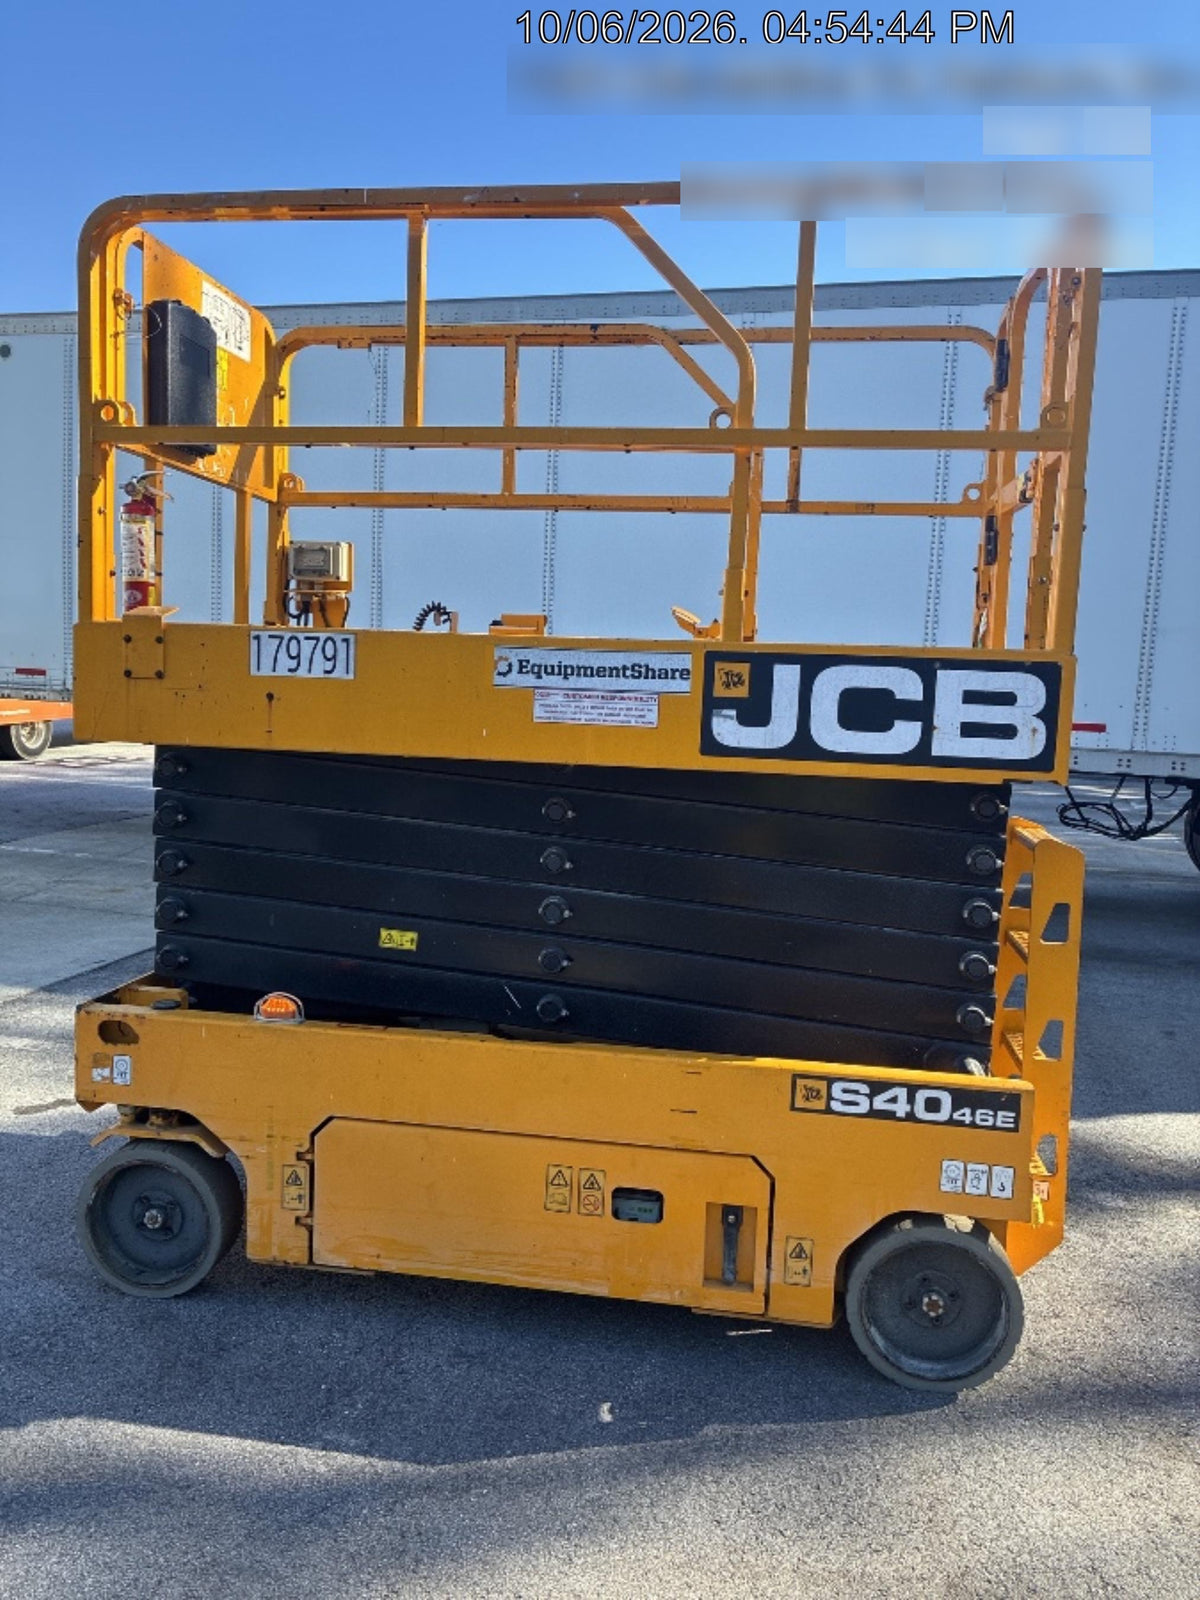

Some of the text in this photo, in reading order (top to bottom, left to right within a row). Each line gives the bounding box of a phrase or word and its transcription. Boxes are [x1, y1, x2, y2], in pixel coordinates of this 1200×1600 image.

[252, 634, 351, 675] 179791
[517, 658, 691, 681] EquipmentShare
[711, 663, 1047, 760] JCB
